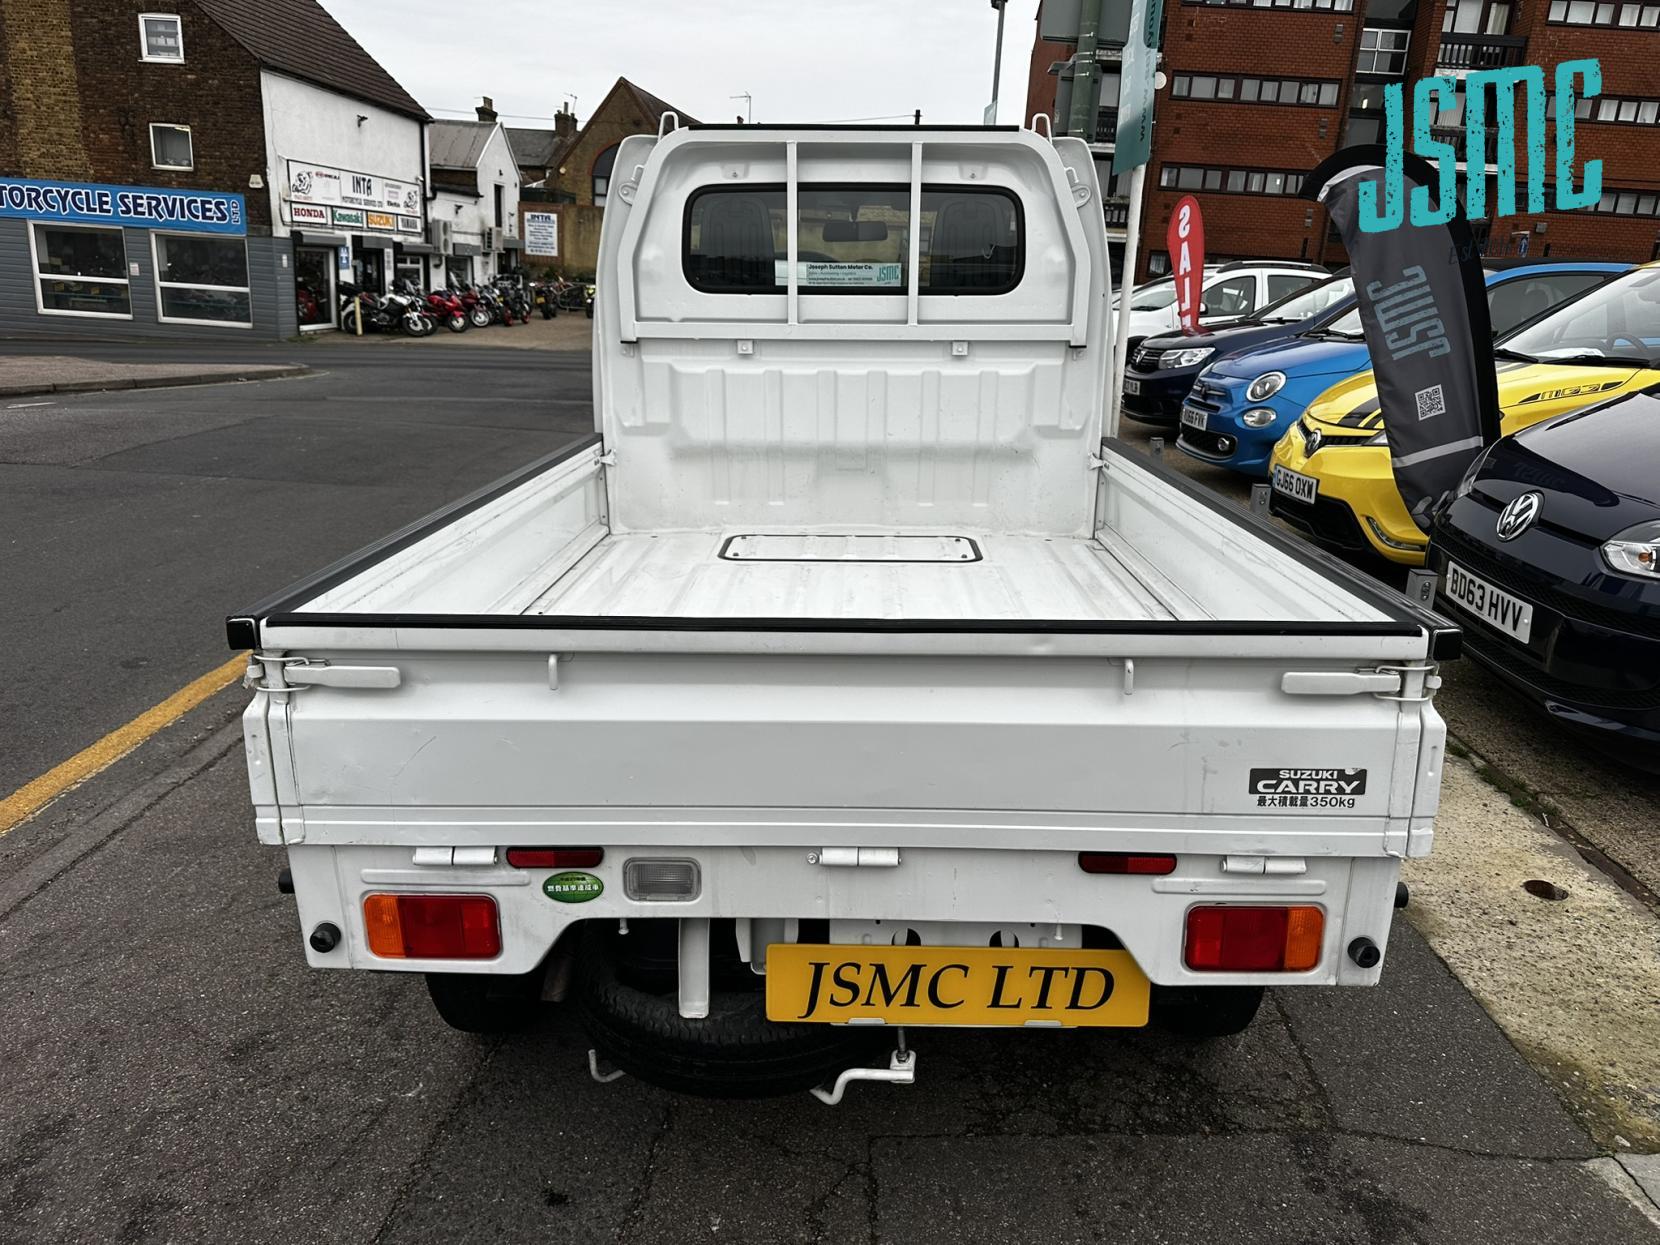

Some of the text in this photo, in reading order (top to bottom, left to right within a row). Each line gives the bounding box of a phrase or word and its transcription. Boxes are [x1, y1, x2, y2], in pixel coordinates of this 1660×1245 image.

[352, 175, 373, 197] INTA
[118, 192, 230, 223] SERVICES
[231, 200, 241, 224] LTD
[293, 207, 325, 219] HONDA
[333, 210, 363, 224] Kawasaki
[368, 213, 395, 227] SUZUKI
[876, 265, 900, 283] JSMC
[1366, 265, 1451, 360] JSMC
[1450, 567, 1523, 632] BD63 HVV
[1279, 769, 1338, 779] SUZUKI
[1256, 780, 1360, 794] CARRY
[1257, 795, 1356, 808] 最大積載量350kg
[797, 962, 1115, 1019] JSMC LTD
